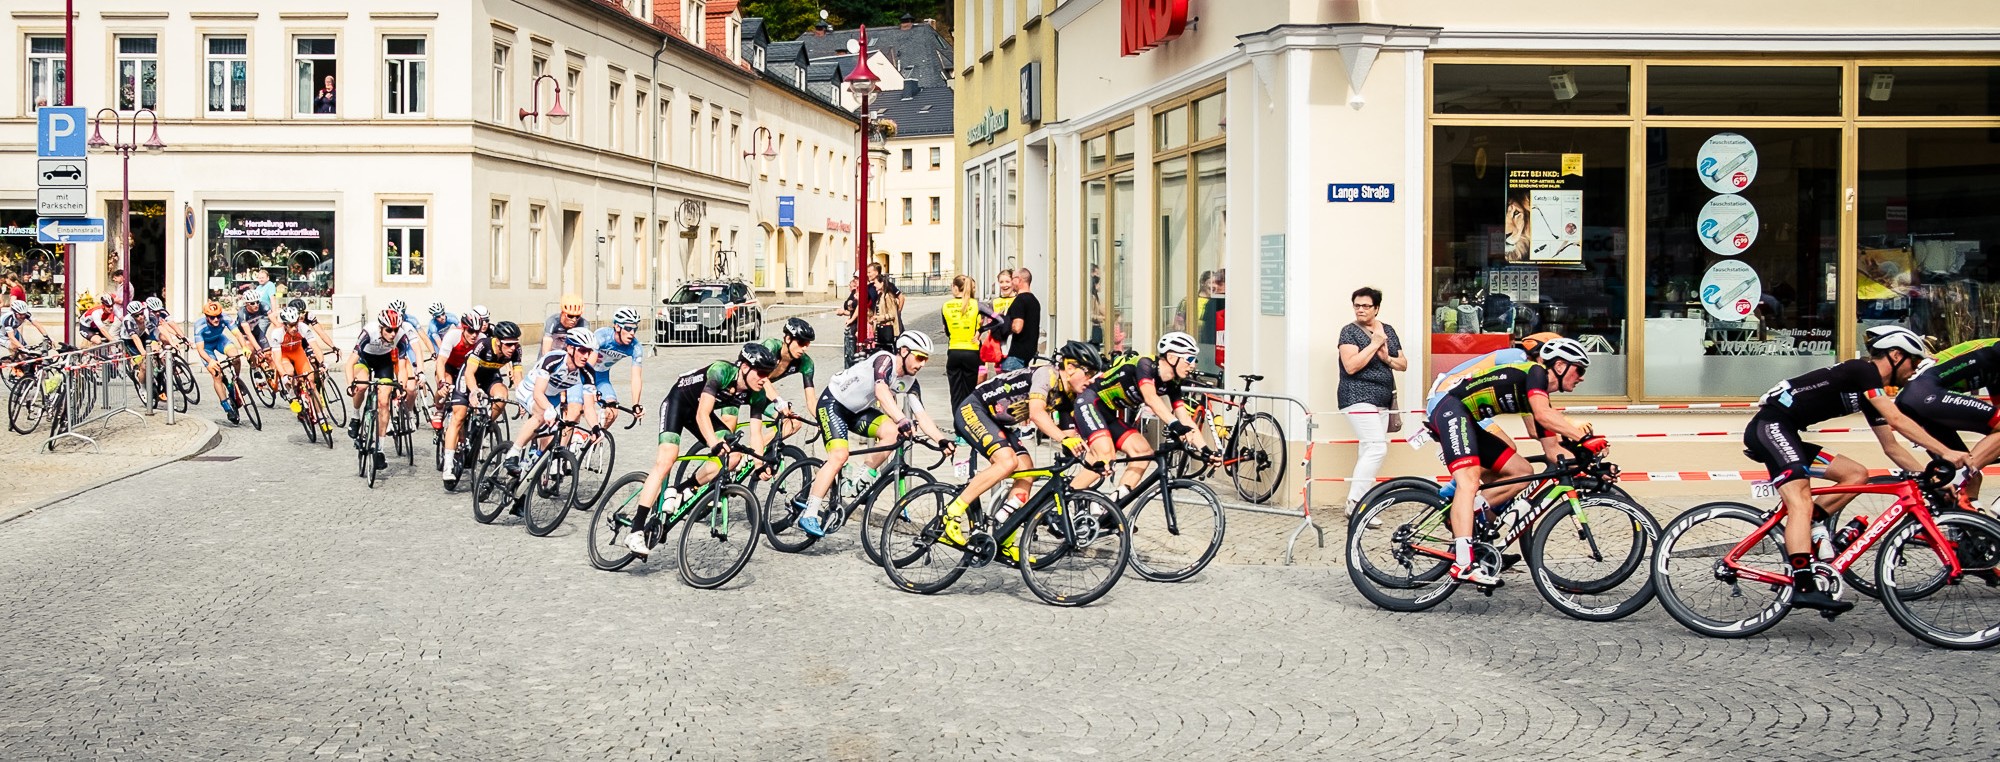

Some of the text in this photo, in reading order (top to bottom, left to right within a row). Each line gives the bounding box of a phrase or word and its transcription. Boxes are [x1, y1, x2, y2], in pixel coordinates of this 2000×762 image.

[1121, 0, 1187, 57] NKD
[49, 113, 75, 152] P
[1509, 170, 1560, 178] JETZT BEI NKD:
[1332, 184, 1390, 202] Lange Straße
[224, 228, 319, 236] Deko- und Geschenkartikeln
[245, 219, 284, 229] Herstellung
[1780, 328, 1832, 338] Online-Shop
[1720, 337, 1832, 353] www.nkd.com
[1769, 422, 1800, 462] SPORTFORUM
[1835, 504, 1903, 570] PINARELLO
